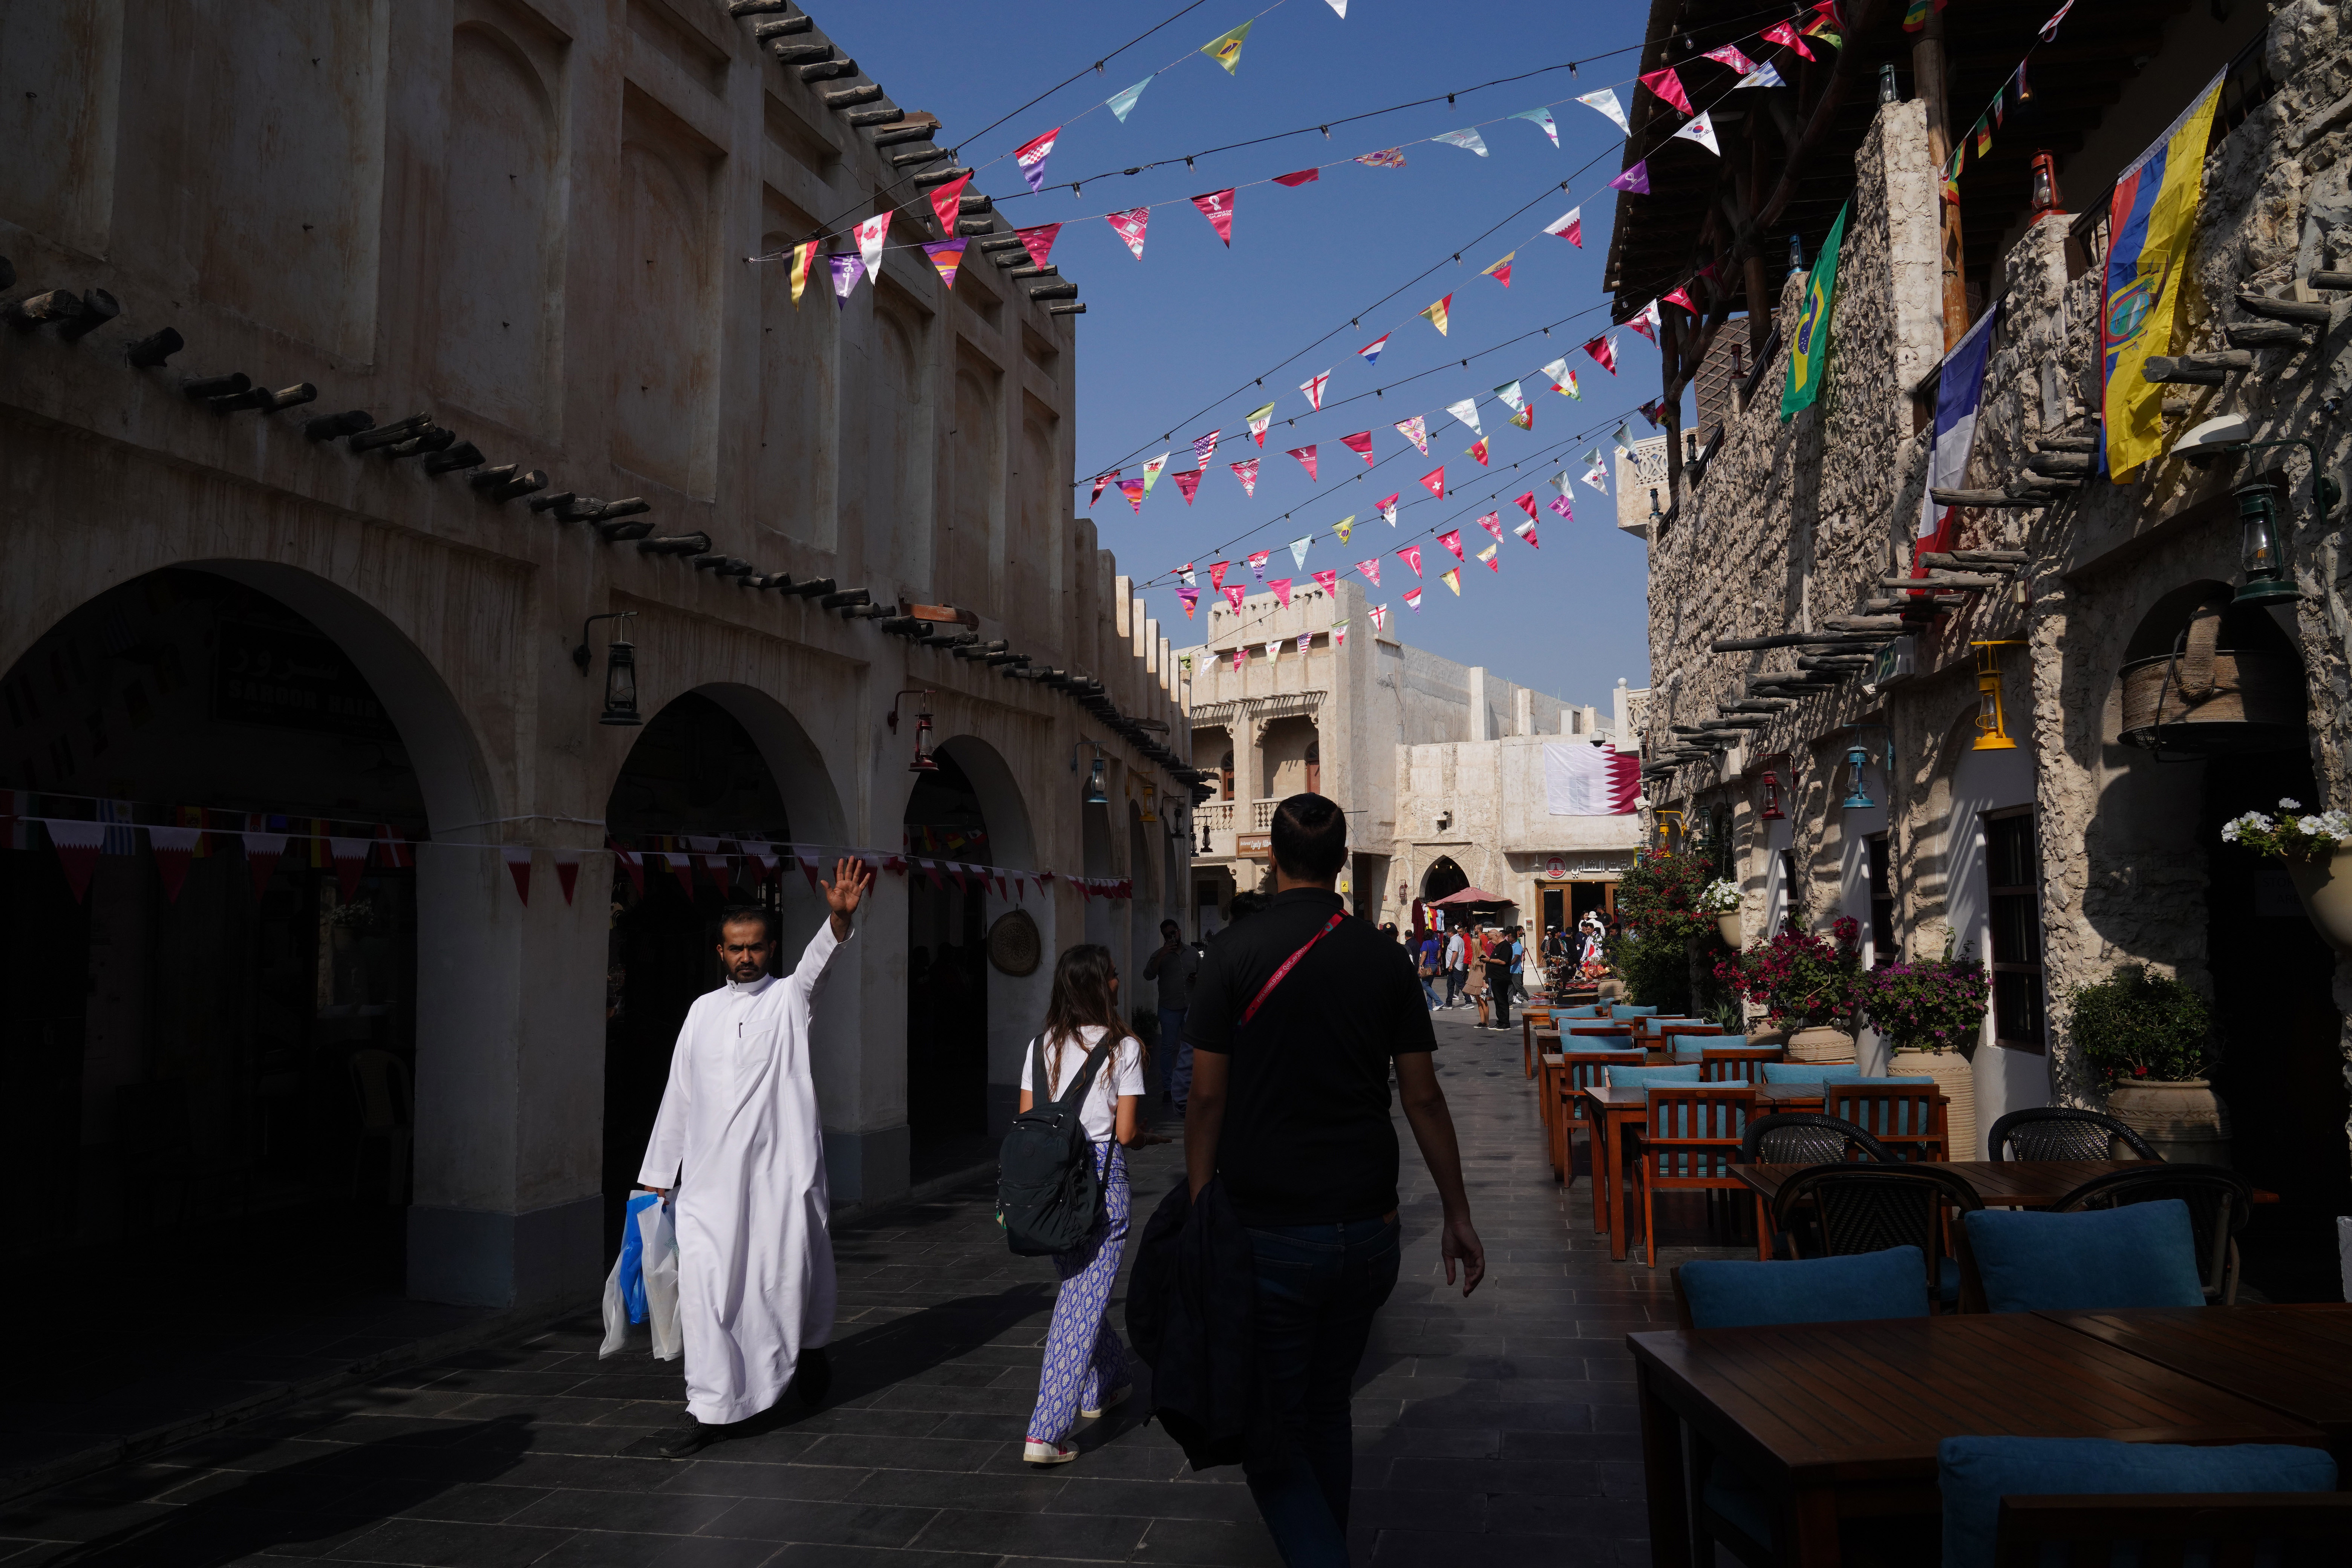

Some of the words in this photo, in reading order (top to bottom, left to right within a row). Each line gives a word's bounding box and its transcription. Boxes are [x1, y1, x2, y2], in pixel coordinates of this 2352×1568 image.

[228, 647, 339, 681] سرور
[228, 679, 317, 710] SAROOR
[328, 694, 377, 718] HAIR
[1251, 841, 1261, 850] Lyaly
[1571, 859, 1605, 877] الشاي
[2263, 878, 2295, 887] STOR
[2277, 894, 2302, 904] ARE
[1257, 993, 1265, 1003] FIFA
[1263, 978, 1276, 994] WORLD
